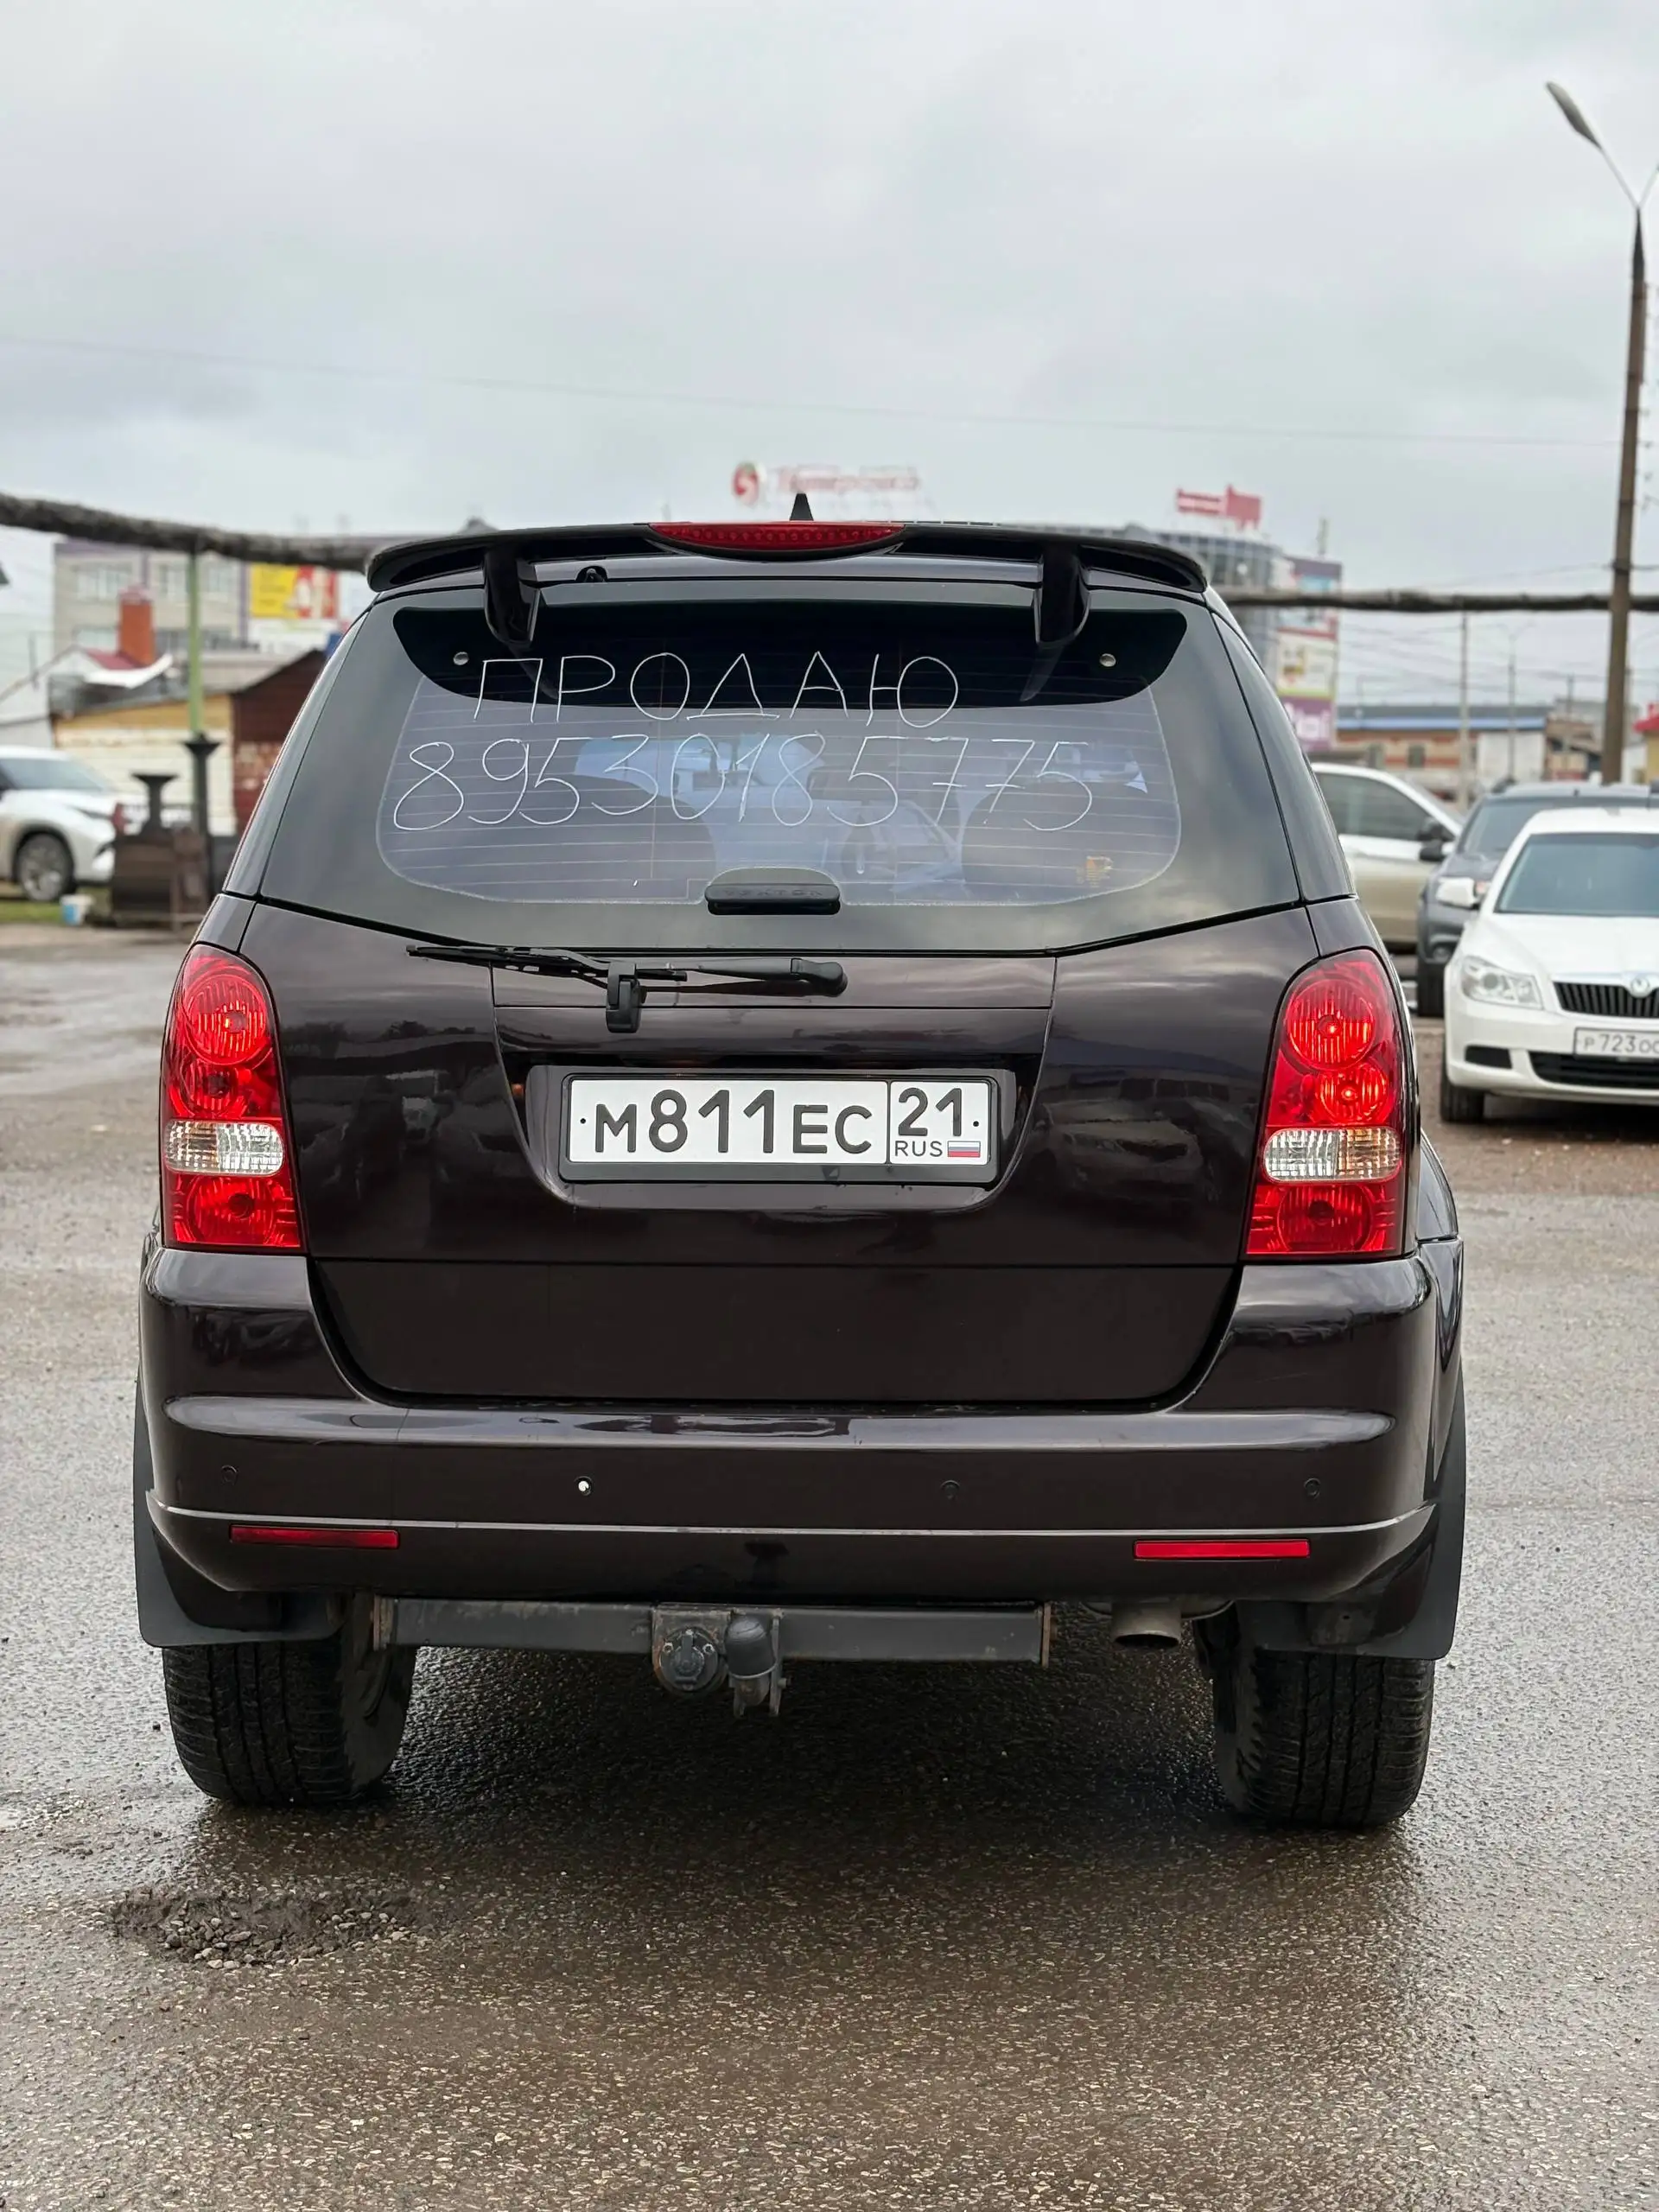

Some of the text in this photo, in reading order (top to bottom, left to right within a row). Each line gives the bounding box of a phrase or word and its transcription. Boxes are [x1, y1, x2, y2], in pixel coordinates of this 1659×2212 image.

[474, 651, 959, 728] ПРОДАЮ
[393, 731, 1092, 831] 89530185775
[595, 1087, 963, 1154] М811ЕС 21
[894, 1140, 943, 1158] RUS
